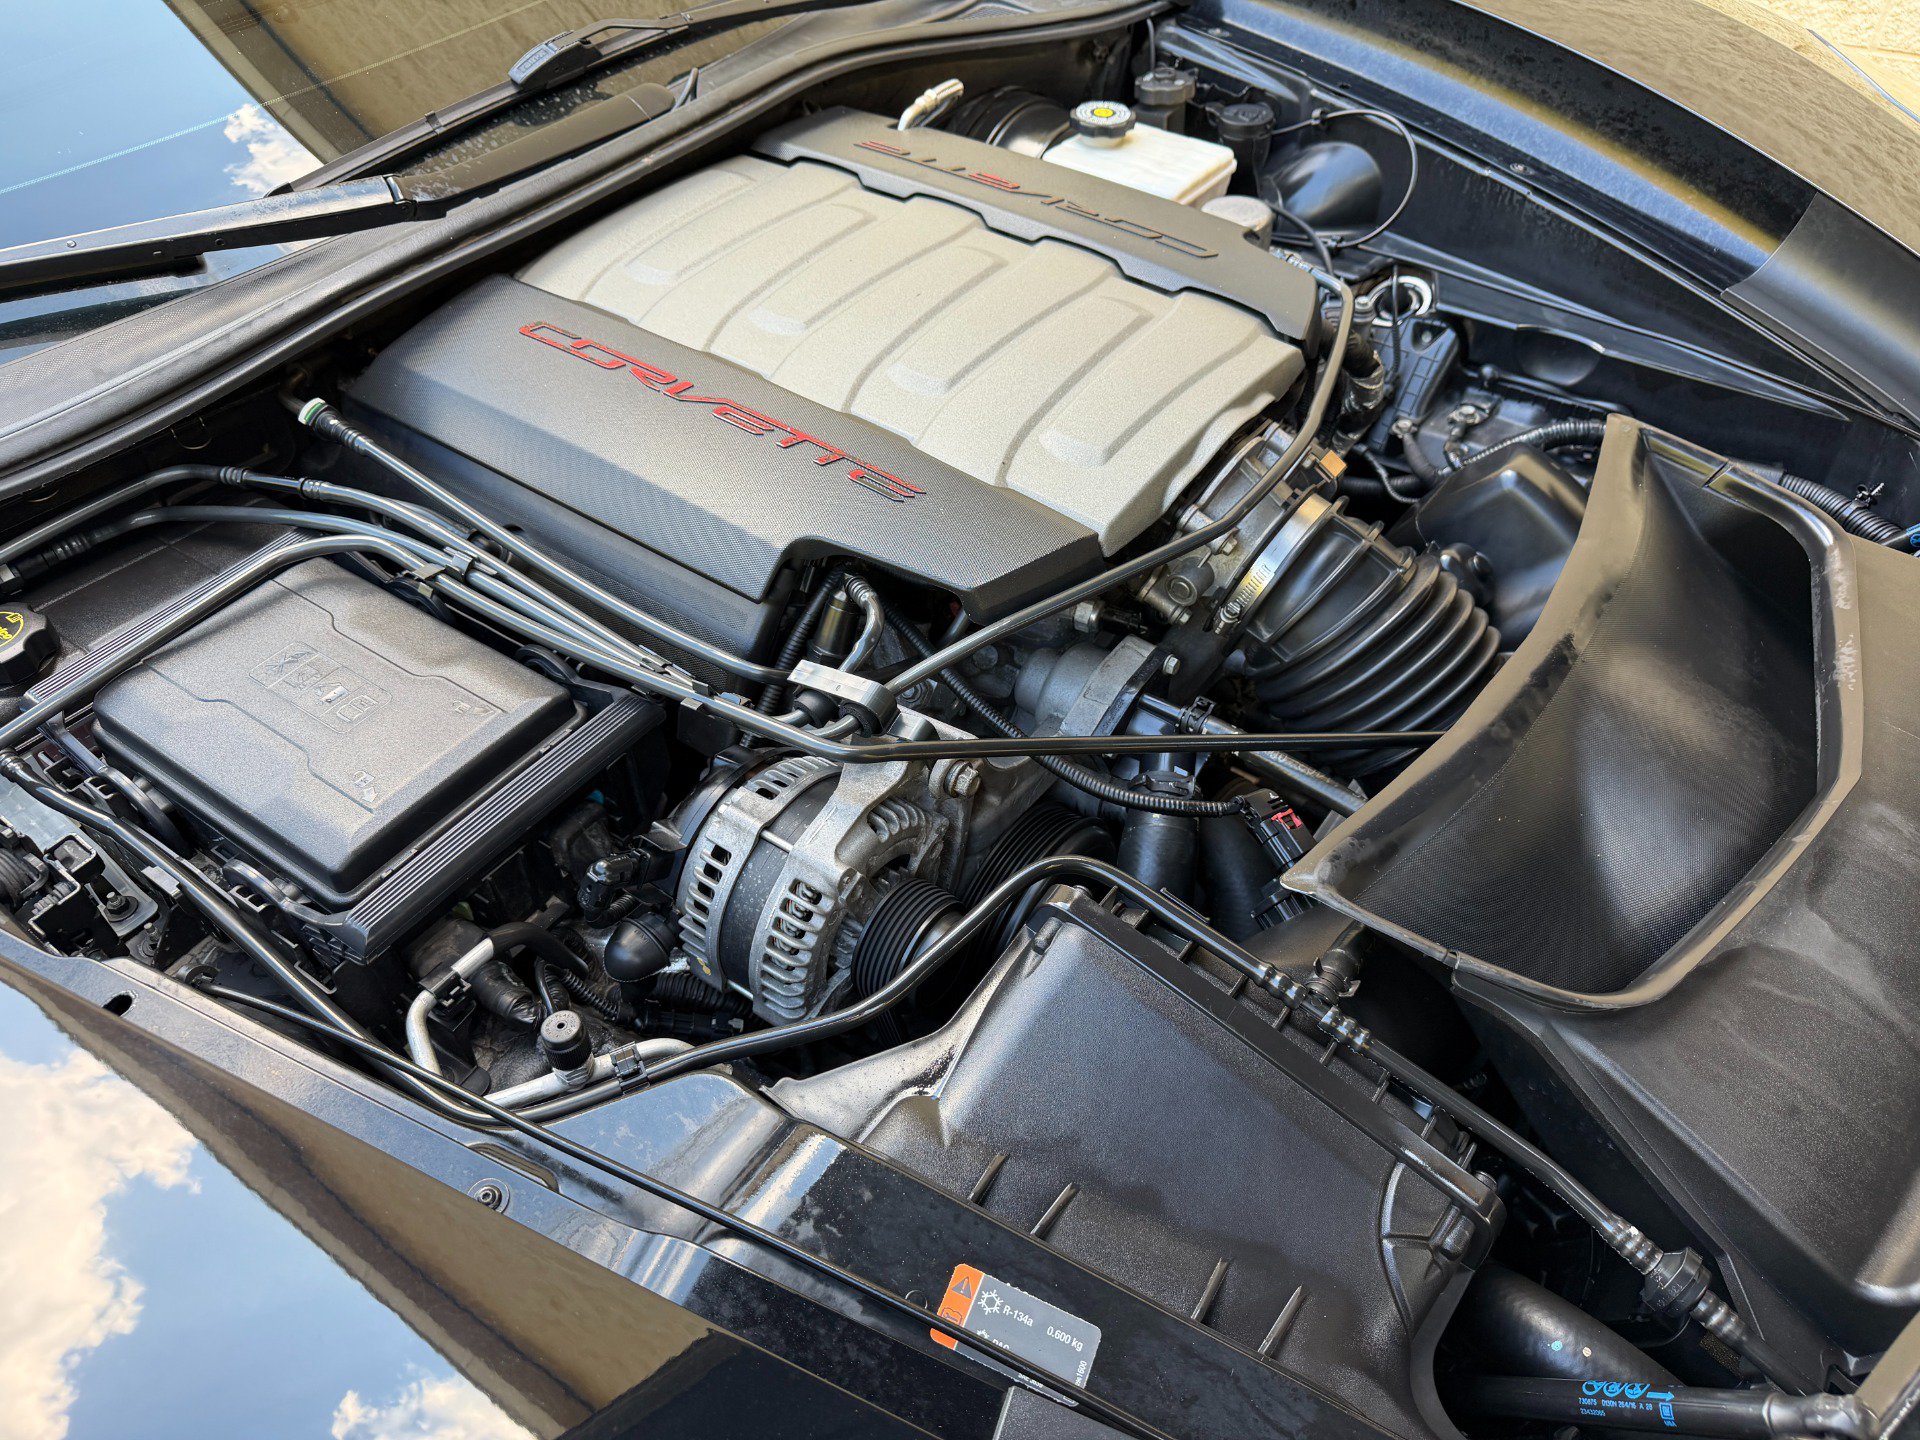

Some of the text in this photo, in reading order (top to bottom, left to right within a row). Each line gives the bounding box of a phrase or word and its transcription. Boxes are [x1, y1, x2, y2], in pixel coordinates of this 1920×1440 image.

[853, 140, 1219, 258] CORVETTE
[518, 321, 927, 502] CORVETTE
[1003, 1305, 1034, 1327] R-134a
[1047, 1326, 1083, 1352] 0.600 kg
